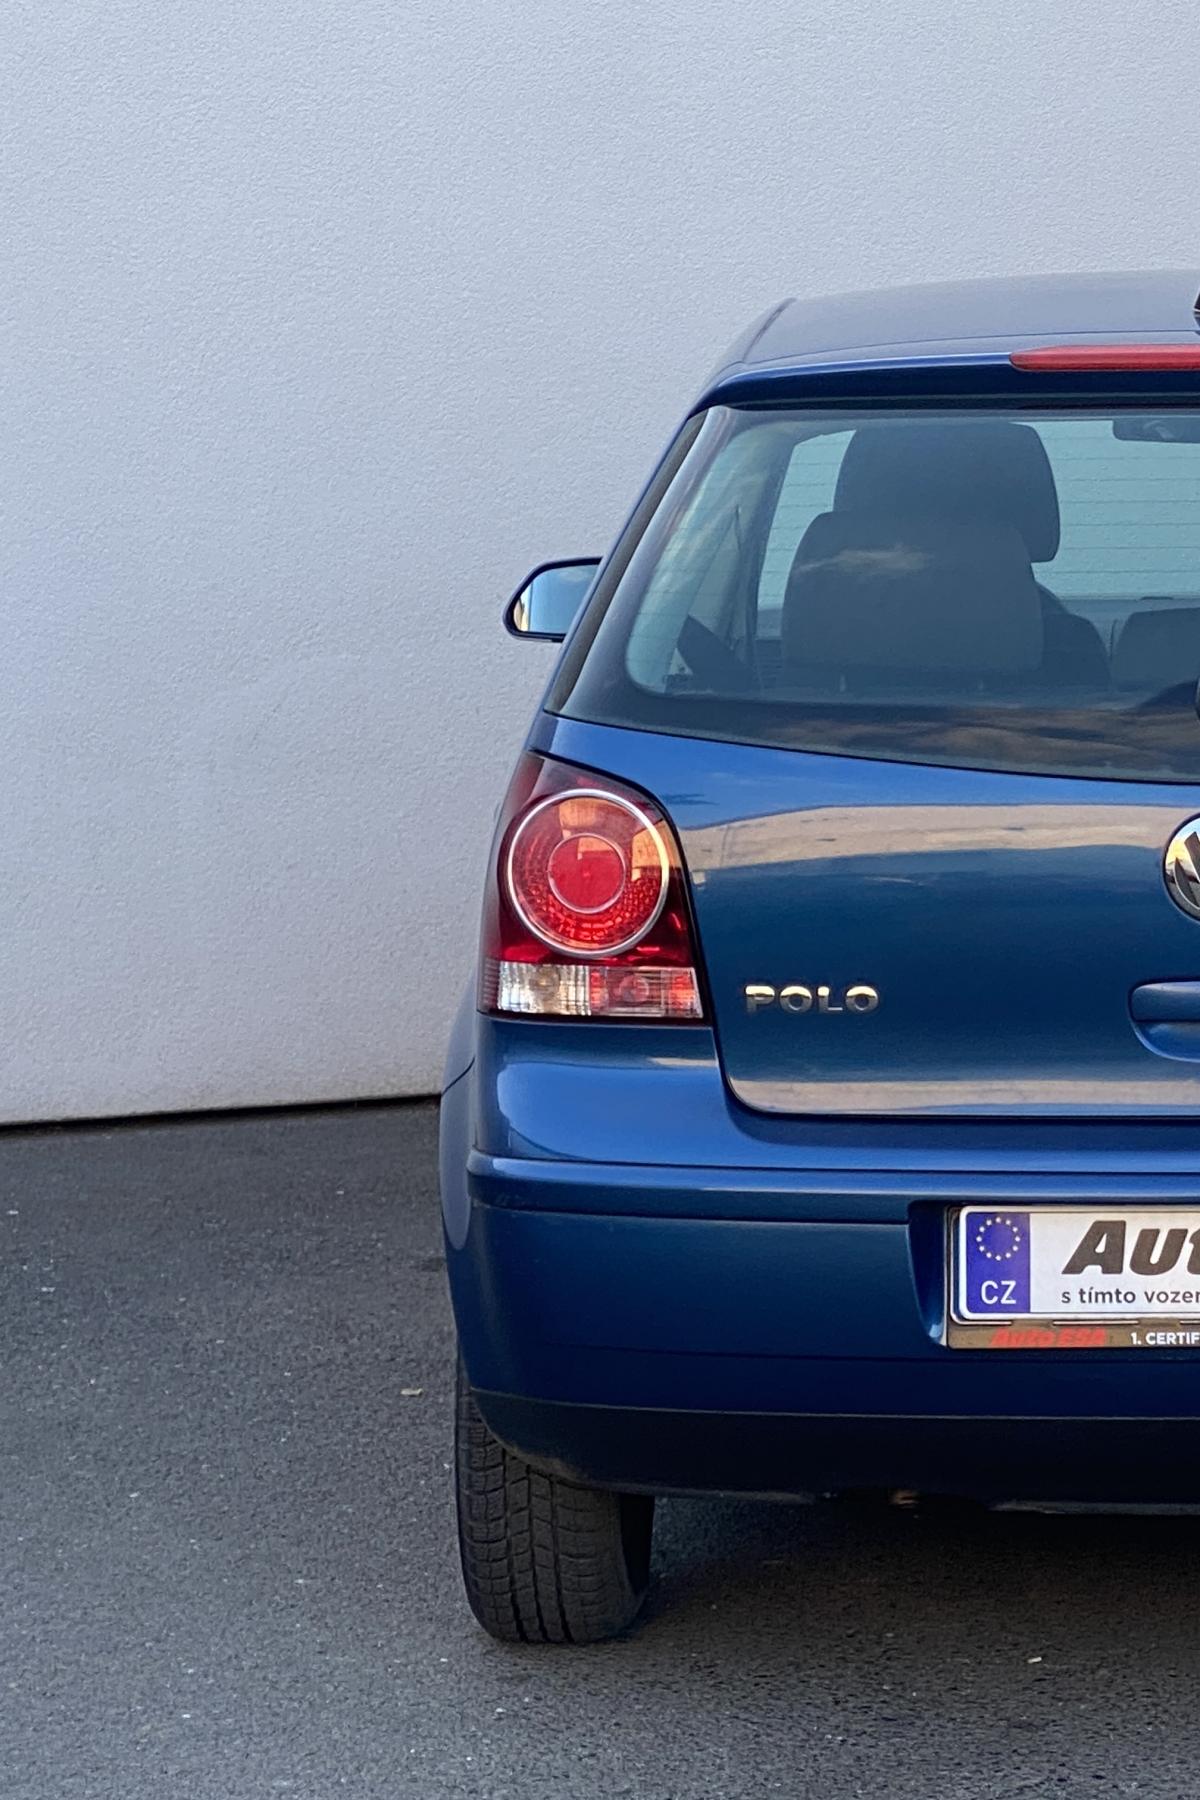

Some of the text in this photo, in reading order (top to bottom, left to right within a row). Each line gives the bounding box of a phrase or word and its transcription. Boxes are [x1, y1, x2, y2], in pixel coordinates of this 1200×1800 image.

[745, 985, 879, 1013] POLO
[980, 1280, 1017, 1304] CZ
[1061, 1290, 1071, 1303] s
[1079, 1286, 1136, 1304] tímto
[1131, 1331, 1142, 1345] 1.
